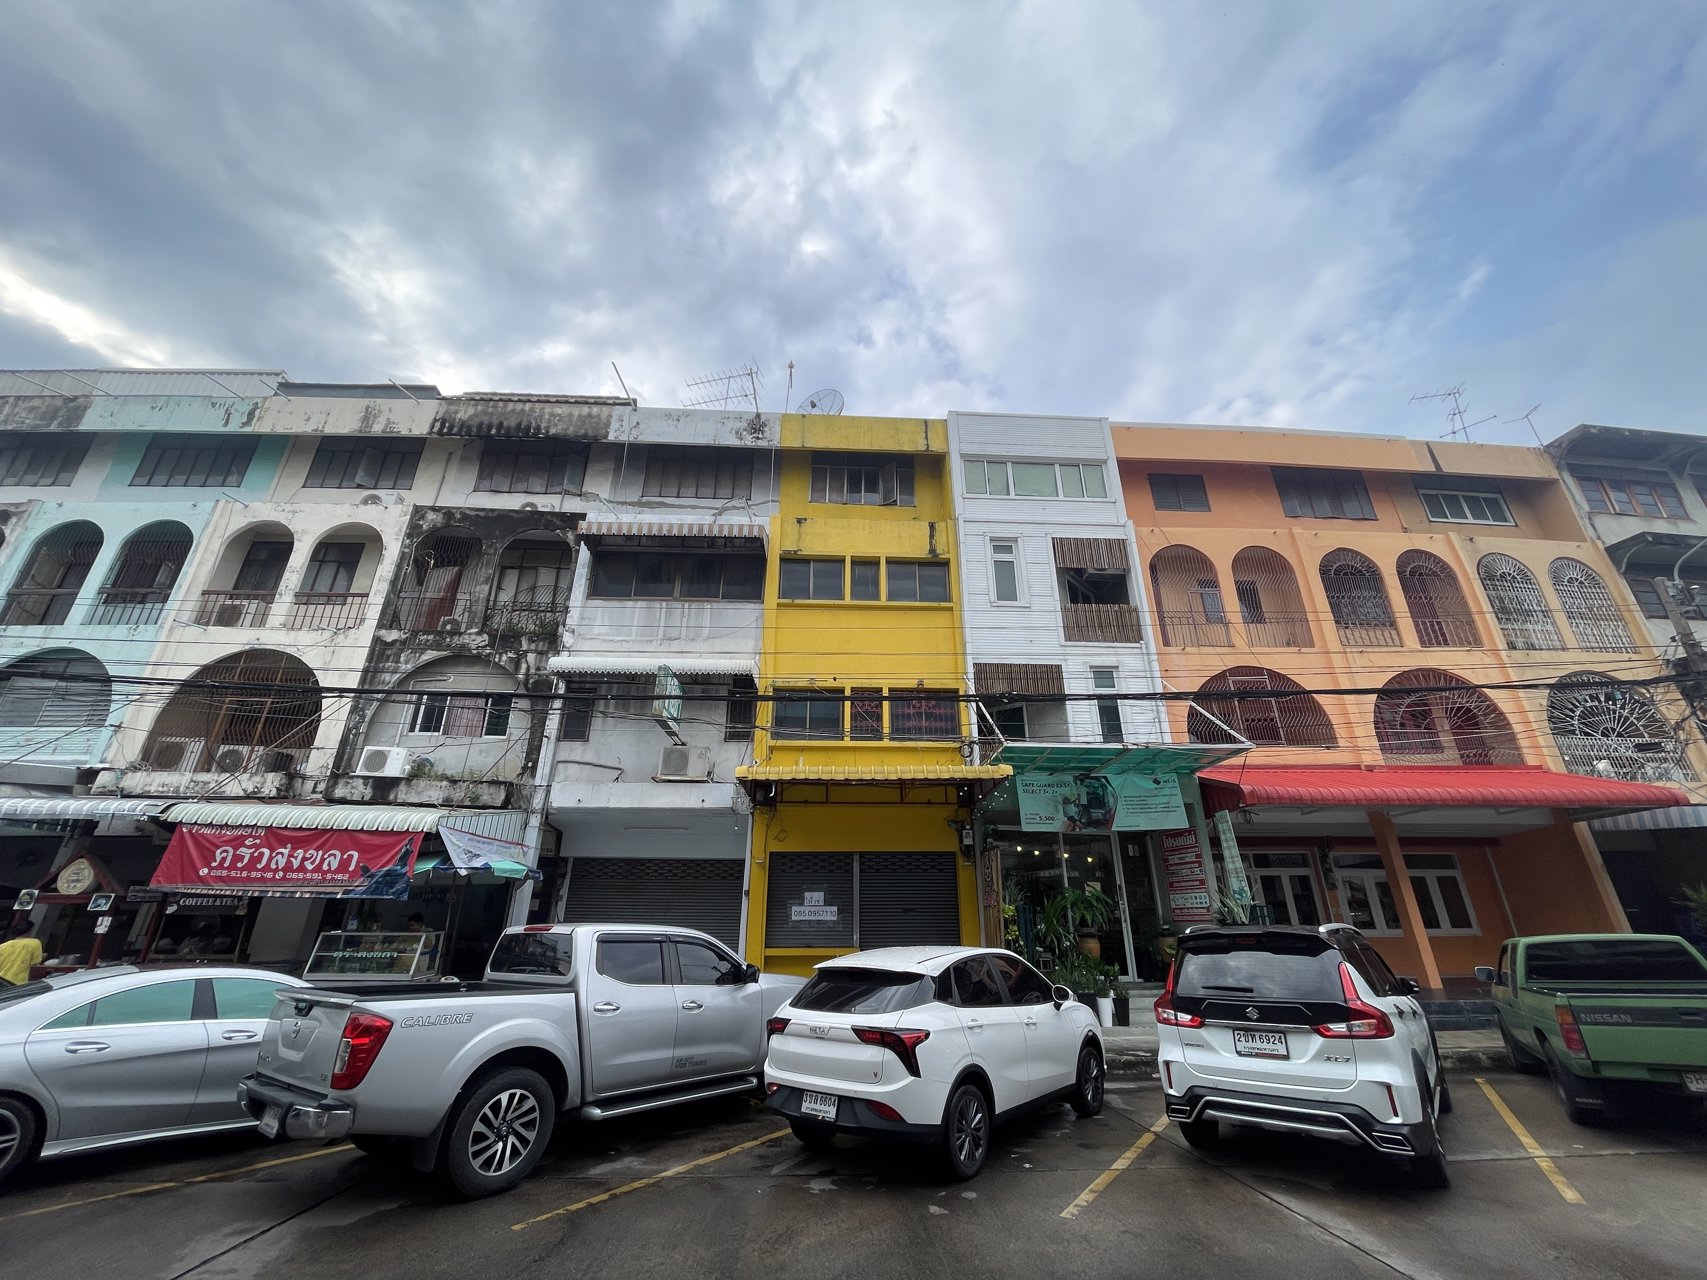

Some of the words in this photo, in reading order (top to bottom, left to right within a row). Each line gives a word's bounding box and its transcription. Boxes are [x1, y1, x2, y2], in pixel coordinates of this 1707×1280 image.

[179, 897, 214, 906] COFFEE
[221, 897, 238, 906] TEA
[400, 1012, 474, 1029] CALIBRE
[1580, 1013, 1633, 1023] NISSAN
[809, 1026, 826, 1034] NETA
[1258, 1034, 1284, 1046] 6924
[1323, 1054, 1352, 1063] XL7
[819, 1095, 838, 1109] 6604
